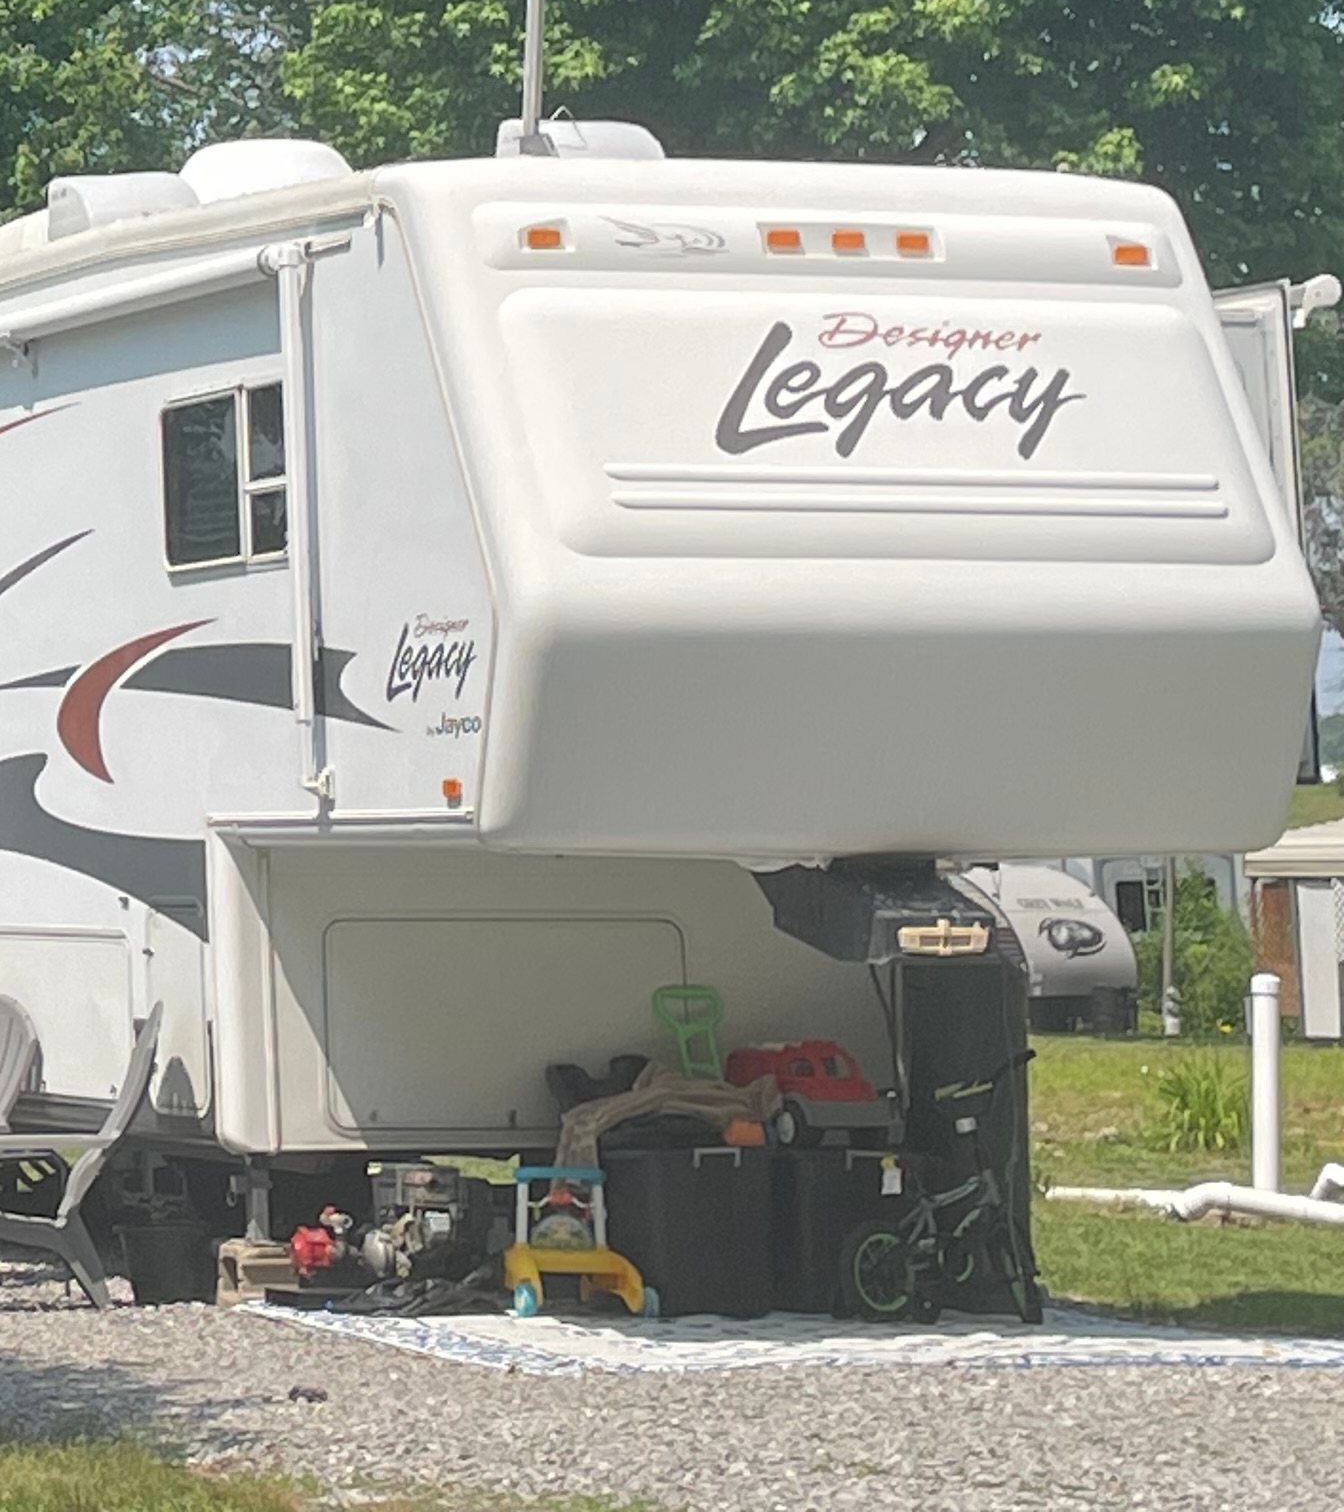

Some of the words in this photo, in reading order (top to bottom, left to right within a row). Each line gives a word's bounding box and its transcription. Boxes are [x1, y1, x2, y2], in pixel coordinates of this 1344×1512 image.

[818, 312, 1041, 359] Designer
[715, 321, 1086, 460] Legacy
[386, 622, 477, 703] Legacy
[435, 712, 482, 739] Jayco
